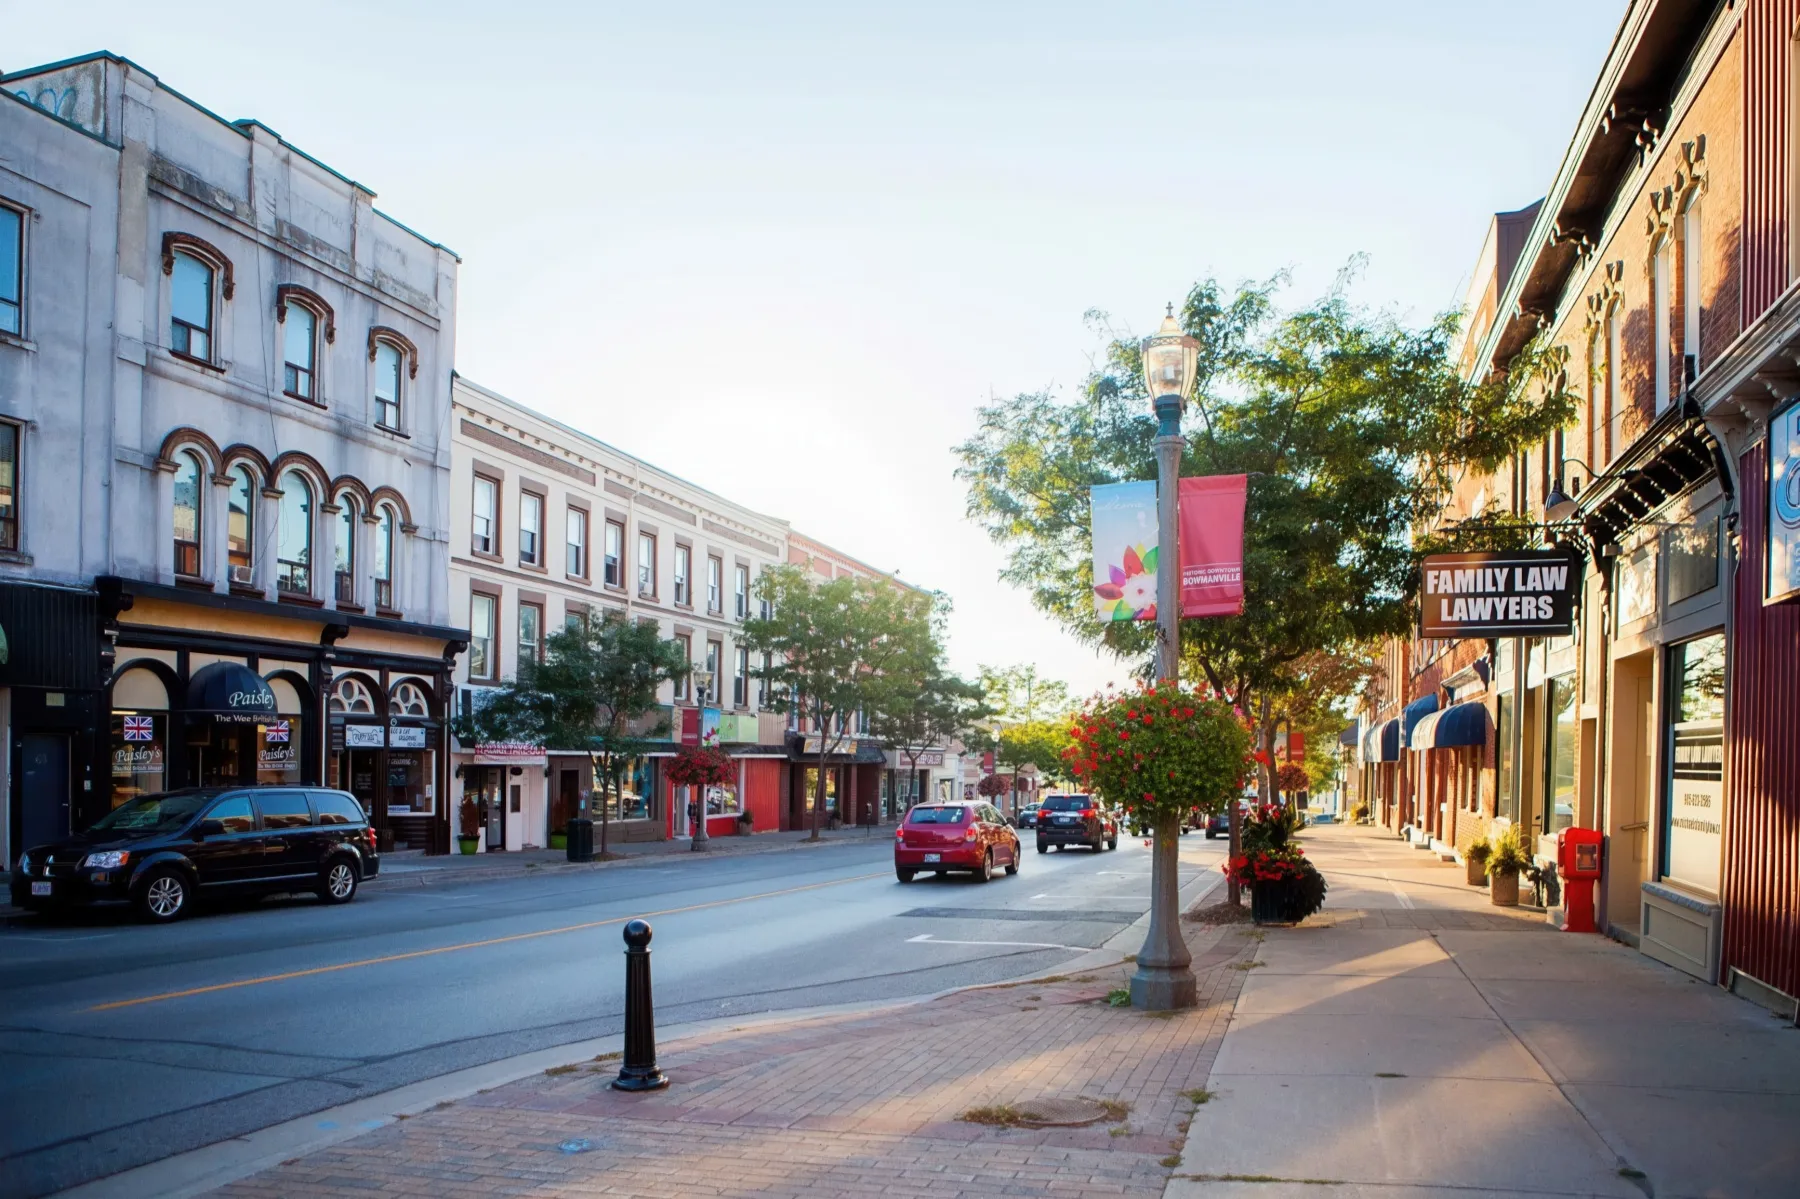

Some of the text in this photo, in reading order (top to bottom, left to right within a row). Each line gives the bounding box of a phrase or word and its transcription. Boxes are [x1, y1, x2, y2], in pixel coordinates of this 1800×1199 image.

[1183, 572, 1241, 586] BOWMANVILLE
[1427, 566, 1568, 594] FAMILY LAW
[1441, 596, 1553, 621] LAWYERS
[214, 714, 231, 722] The
[233, 714, 251, 722] Wee
[115, 745, 161, 764] Paisley's
[258, 746, 295, 762] Paisley's
